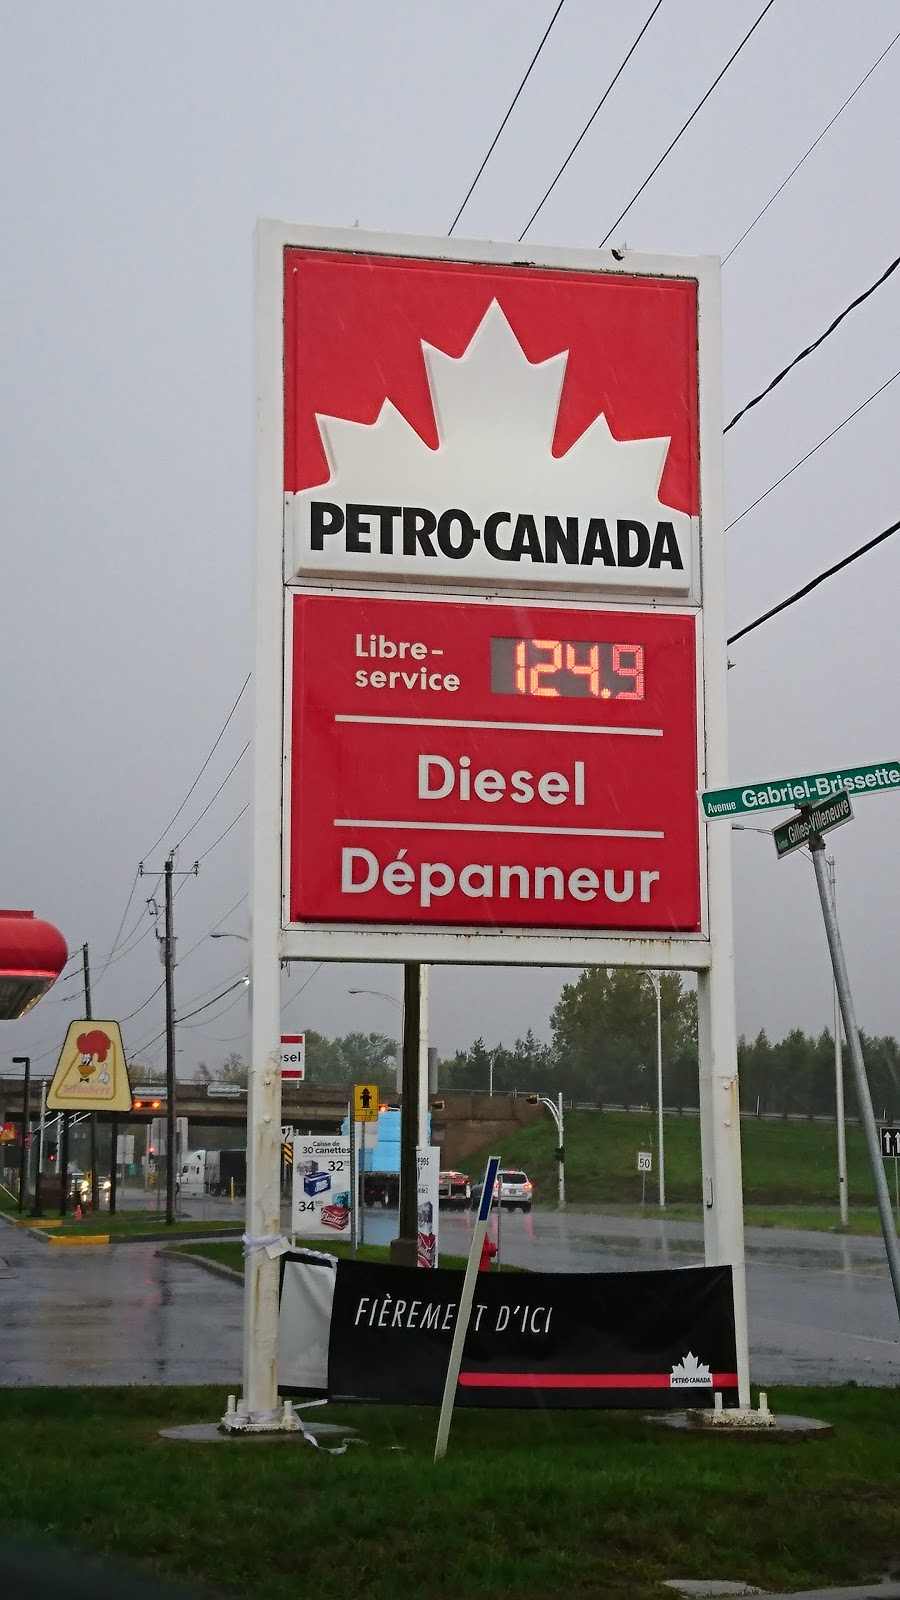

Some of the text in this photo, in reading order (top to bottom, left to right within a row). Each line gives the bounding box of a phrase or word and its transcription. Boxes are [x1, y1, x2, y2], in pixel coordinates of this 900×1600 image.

[310, 500, 684, 570] PETRO-CANADA
[355, 633, 444, 660] Libre-
[355, 667, 461, 692] service
[514, 639, 645, 700] 124.9
[418, 754, 586, 806] Diesel
[707, 769, 900, 814] Avenue Gabriel-Brissette
[788, 799, 849, 843] Gilles-Villeneuve
[341, 847, 660, 907] Dépanneur
[280, 1052, 301, 1062] sel
[302, 1146, 313, 1154] 30
[639, 1159, 650, 1169] 50
[354, 1293, 553, 1333] FIÈREMET D'ICI
